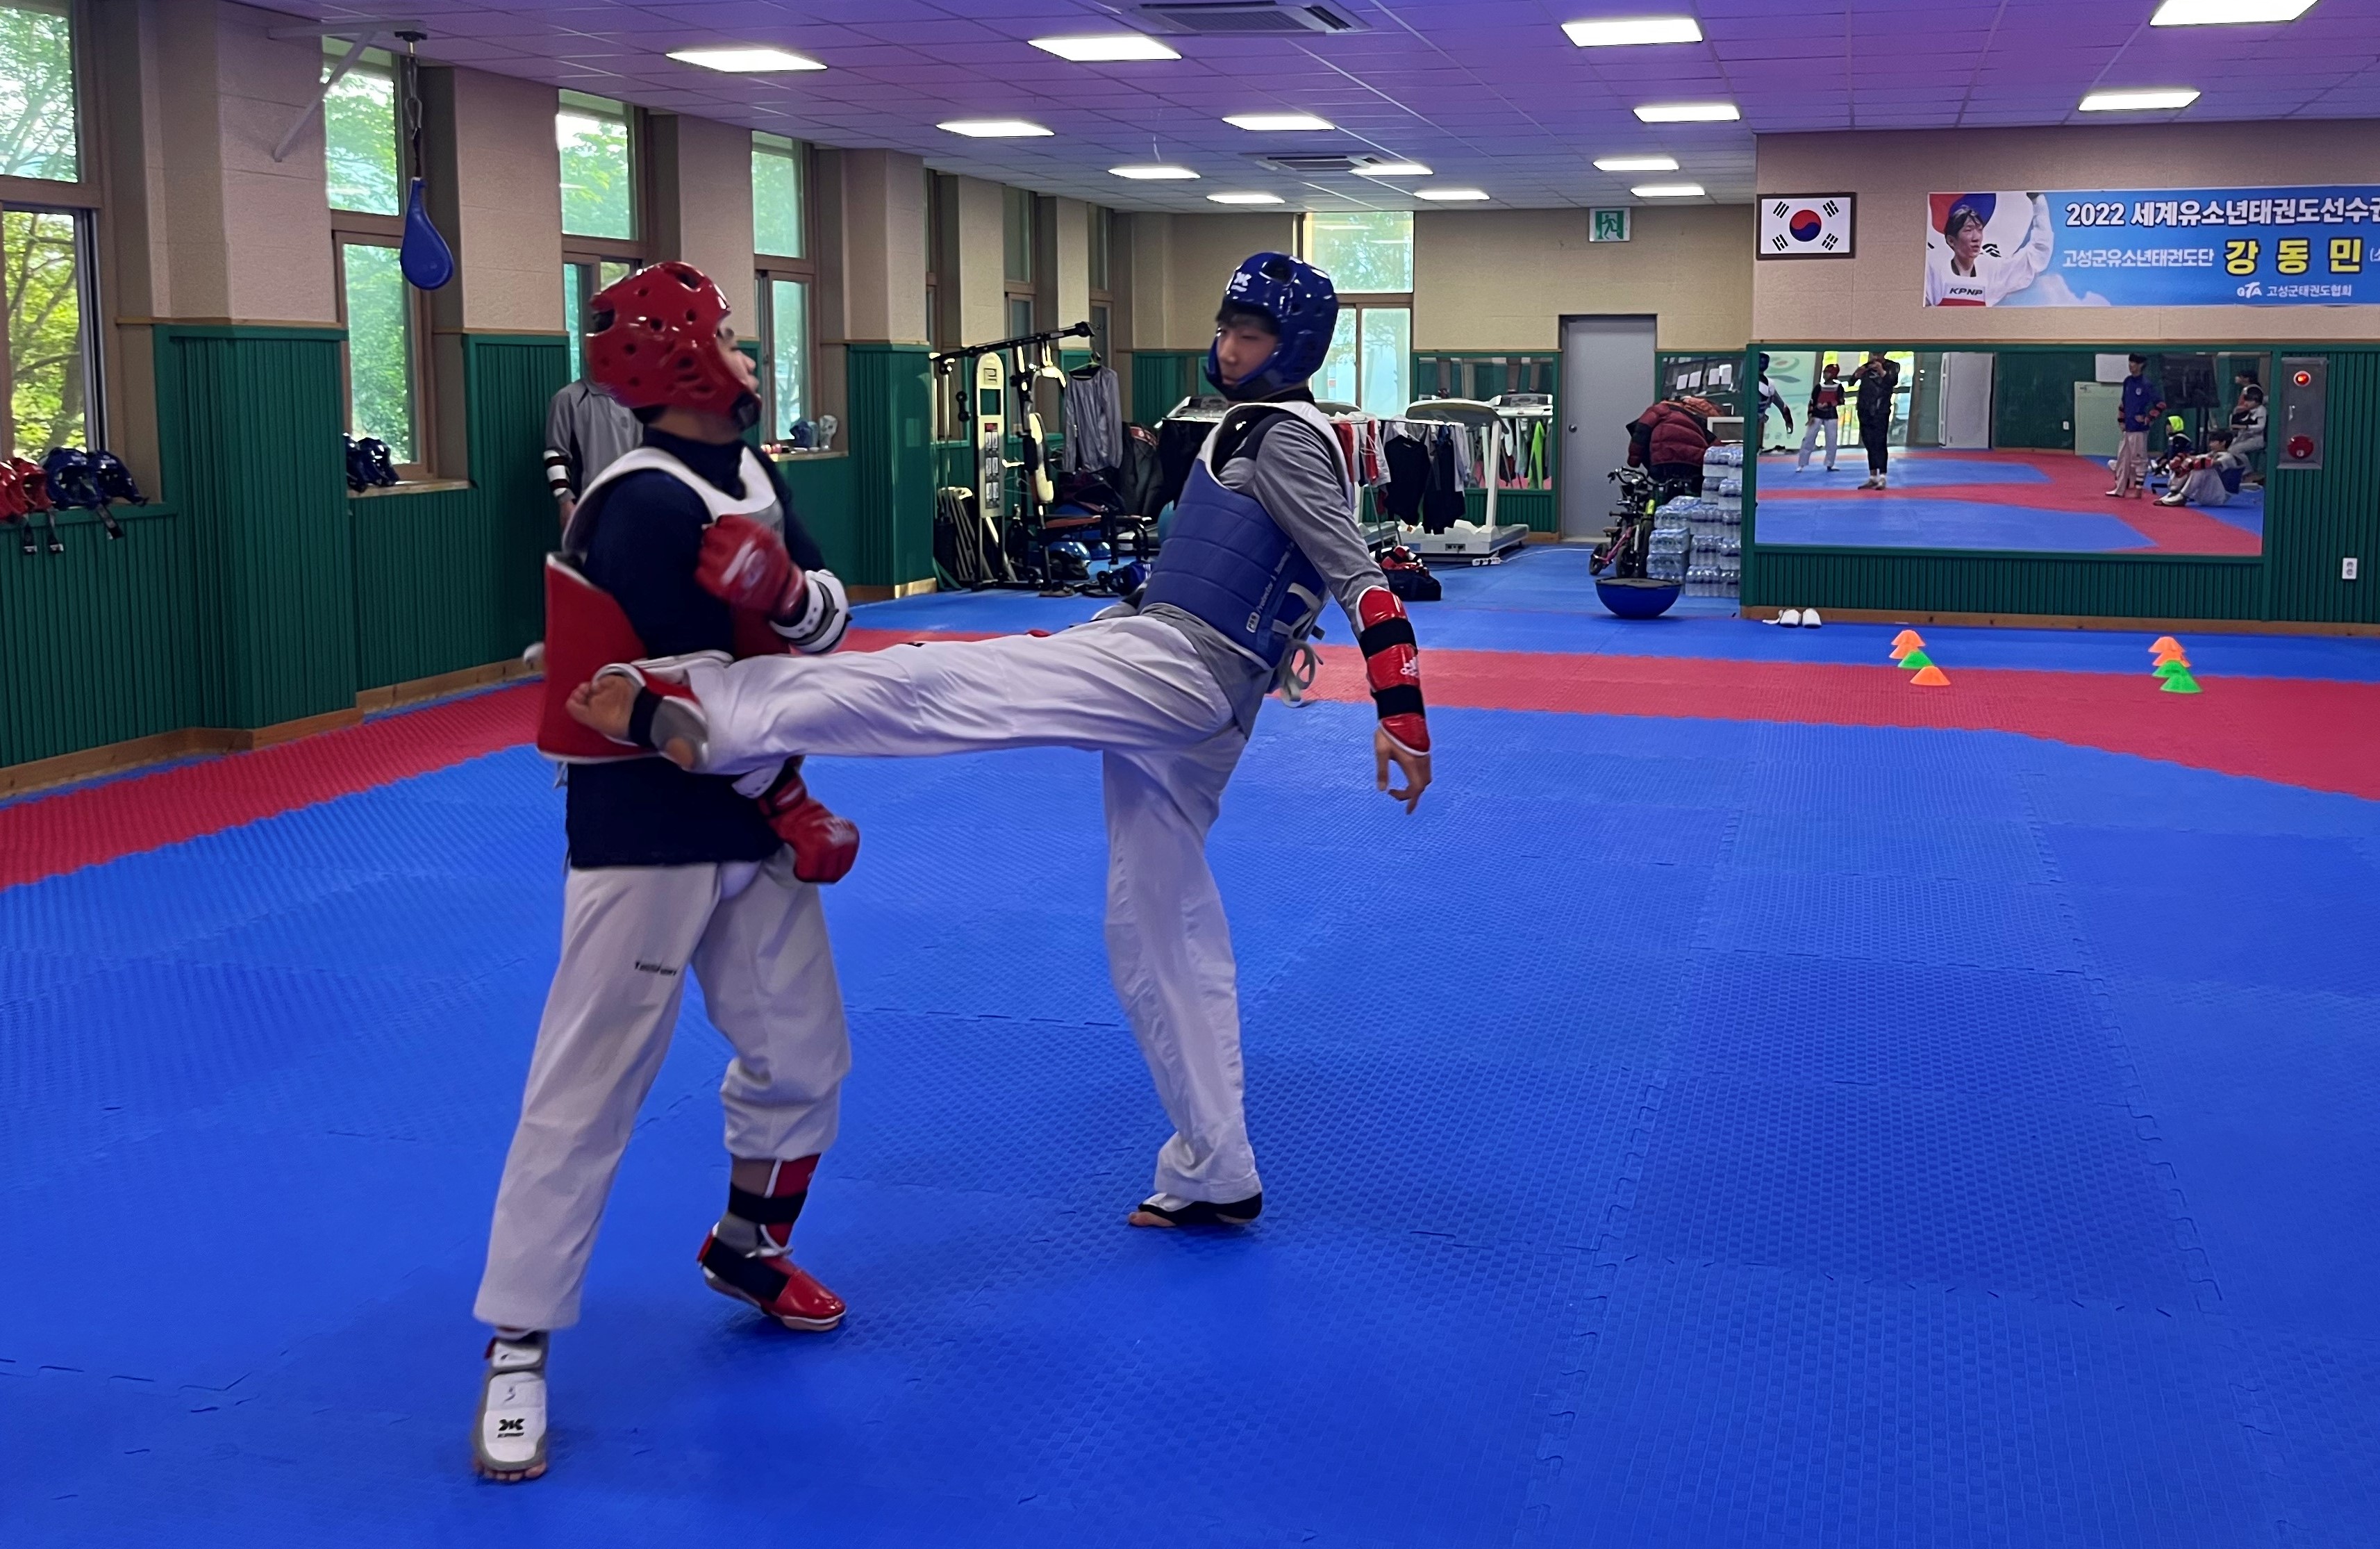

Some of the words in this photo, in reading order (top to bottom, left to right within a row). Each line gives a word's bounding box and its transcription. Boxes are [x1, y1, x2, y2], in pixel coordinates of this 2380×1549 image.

[2065, 202, 2125, 226] 2022
[2062, 248, 2215, 267] 고성군유소년태권도단
[2225, 240, 2258, 274] 강
[2277, 239, 2308, 274] 동
[2329, 238, 2361, 272] 민
[1949, 288, 1983, 296] KPNP
[2266, 284, 2352, 297] 고성군태권도협회
